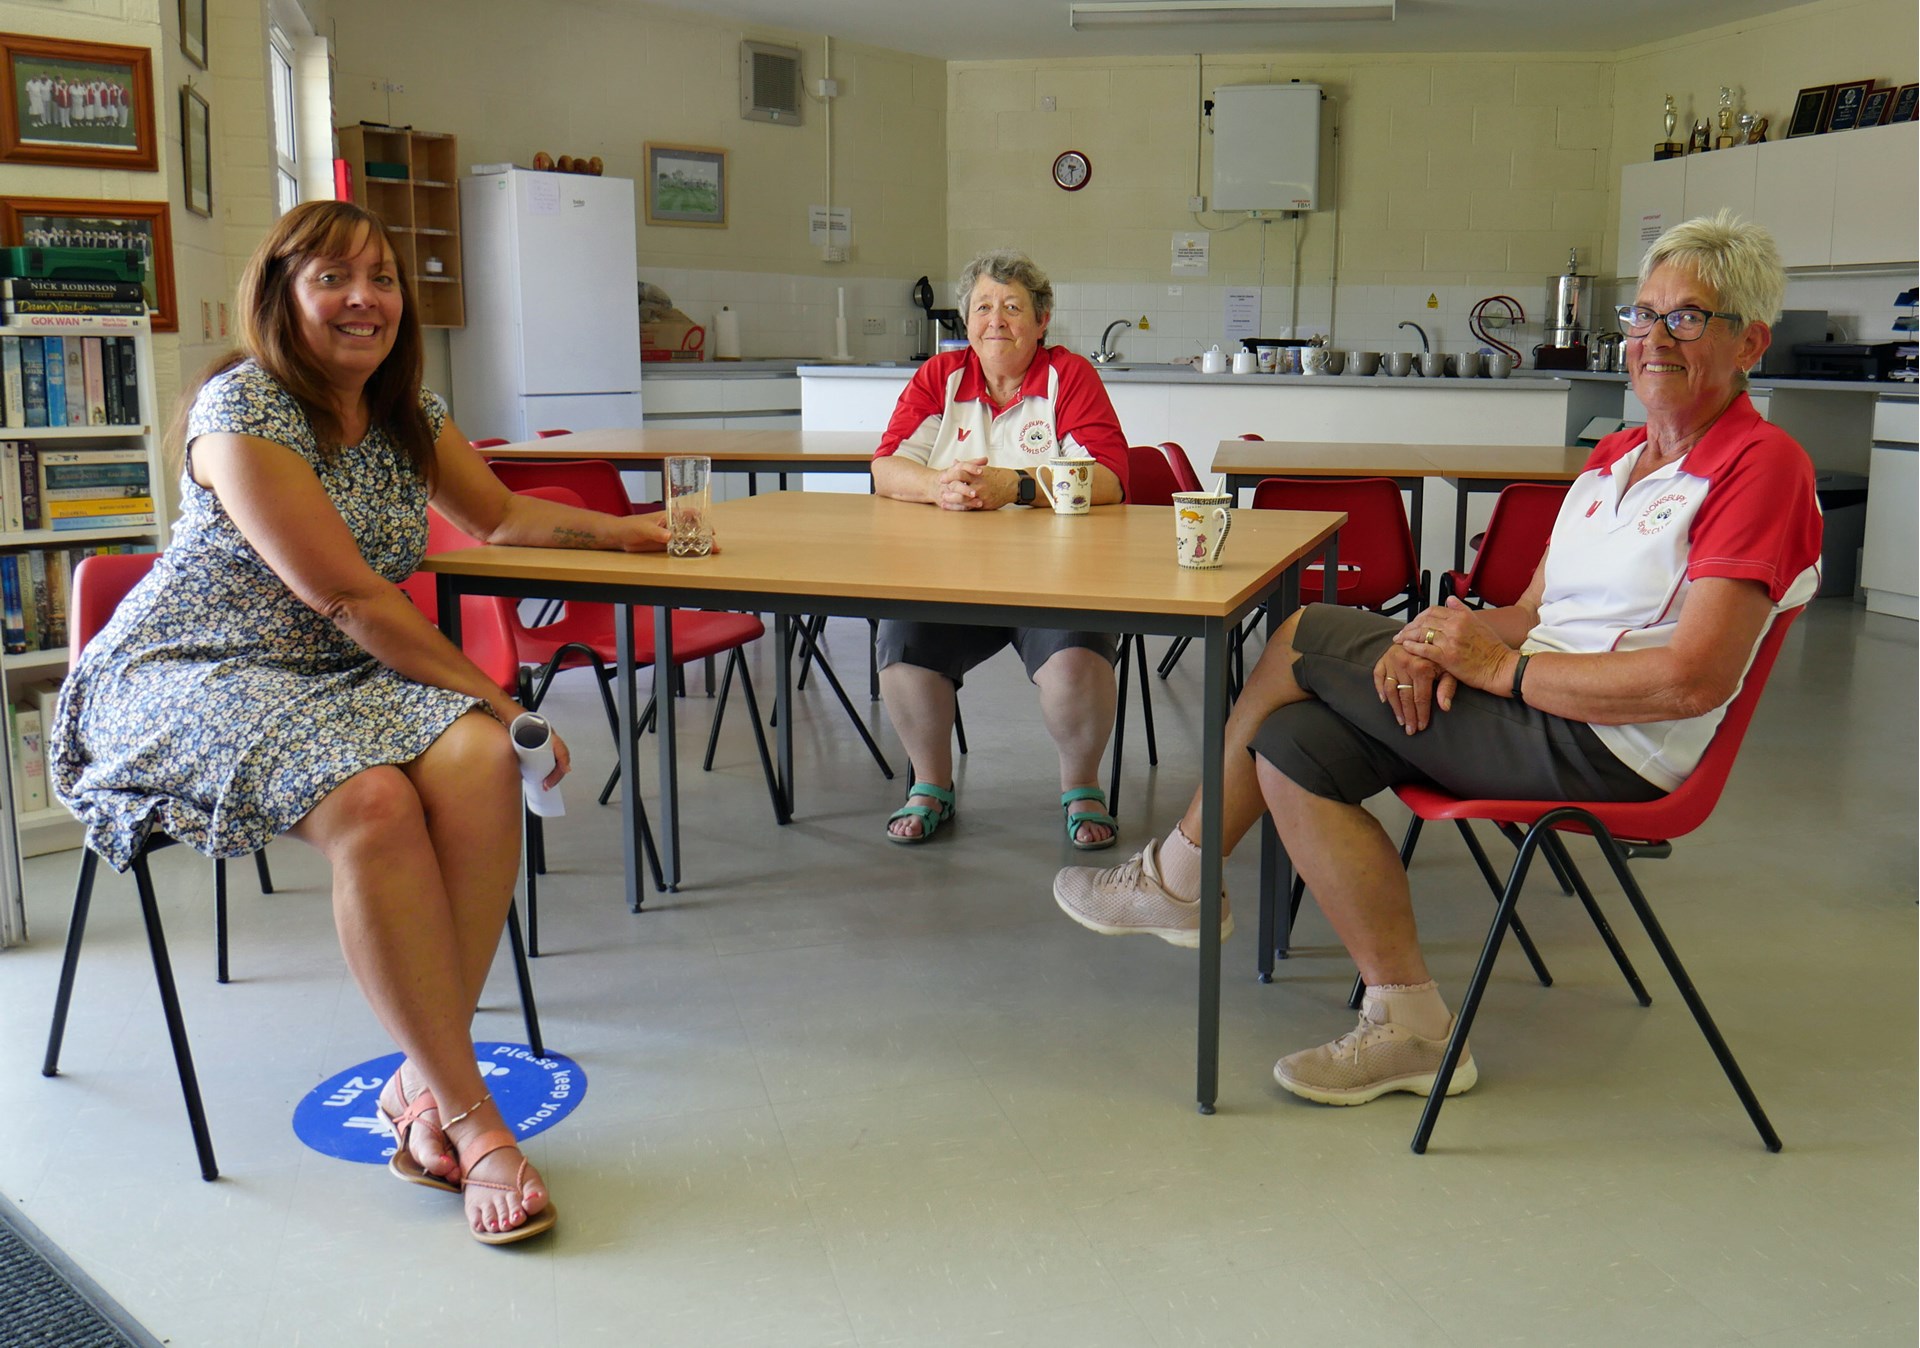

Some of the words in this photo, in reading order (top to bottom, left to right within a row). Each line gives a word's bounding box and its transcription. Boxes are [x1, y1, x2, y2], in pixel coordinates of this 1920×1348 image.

[30, 282, 58, 291] NICK
[61, 283, 117, 292] ROBINSON
[17, 300, 52, 312] Dame
[31, 316, 54, 326] GOK
[56, 317, 80, 326] WAN
[1020, 443, 1040, 454] BOWLS
[549, 1069, 572, 1099] keep
[517, 1102, 561, 1131] your
